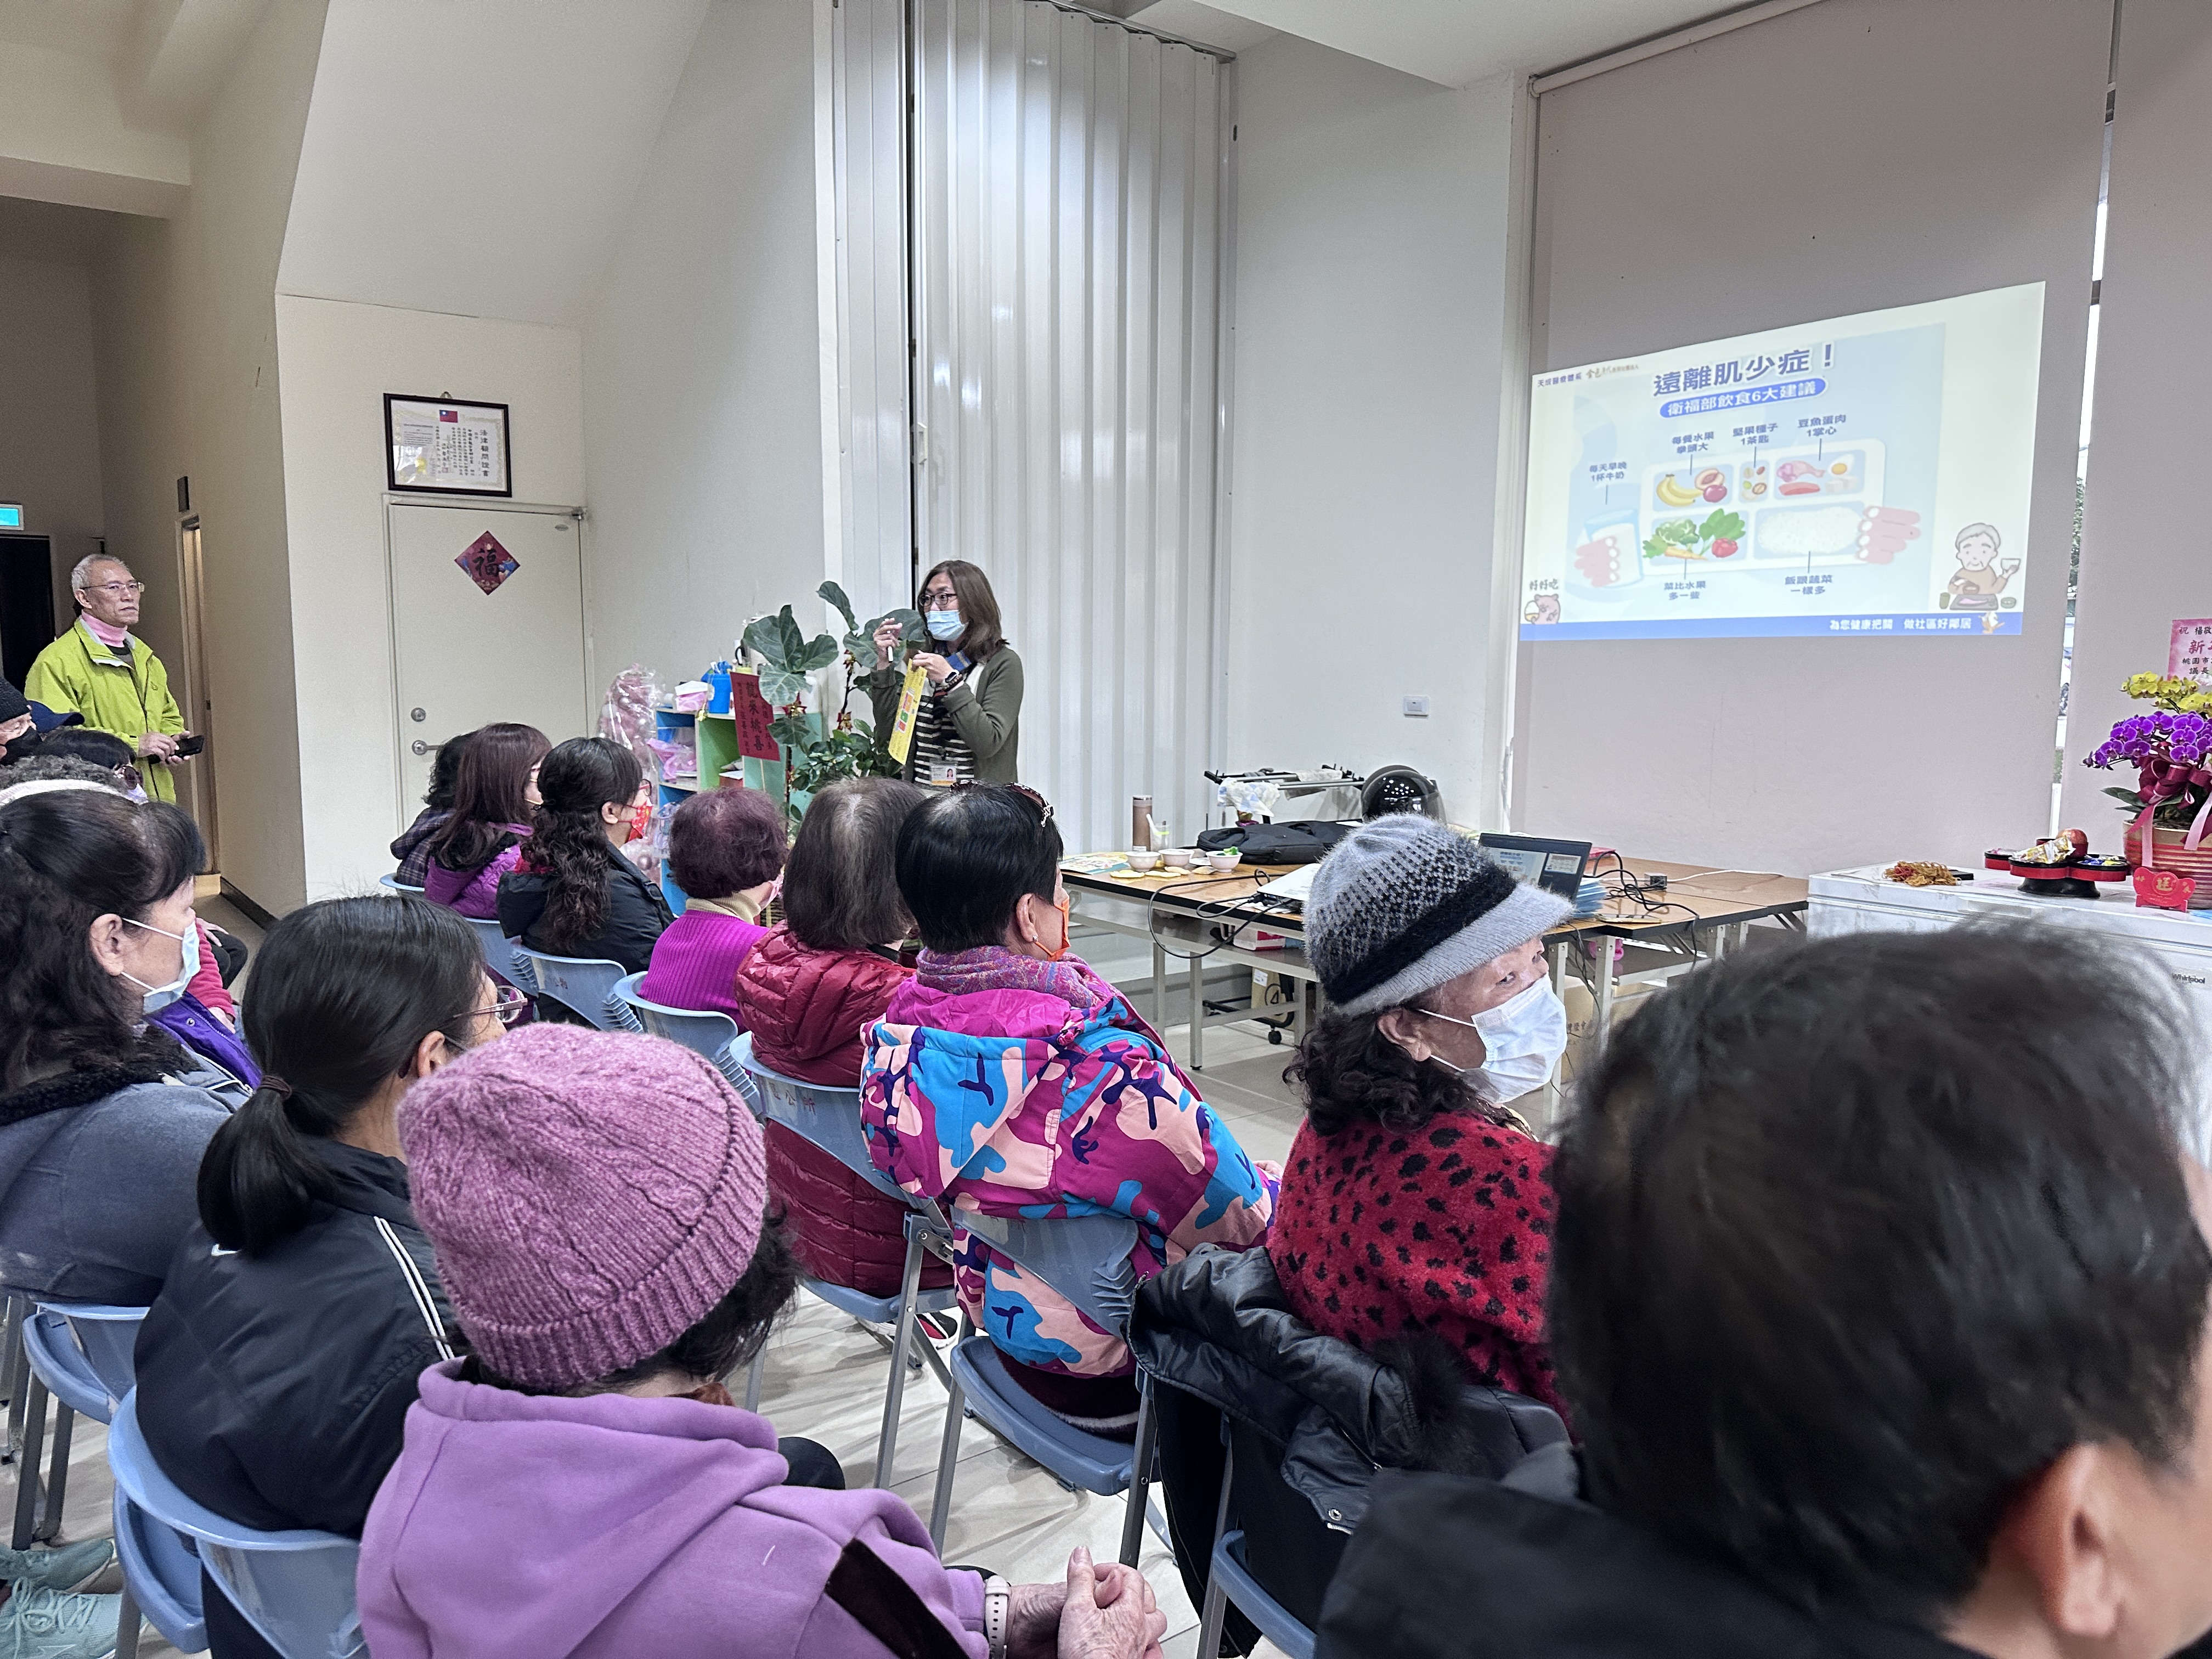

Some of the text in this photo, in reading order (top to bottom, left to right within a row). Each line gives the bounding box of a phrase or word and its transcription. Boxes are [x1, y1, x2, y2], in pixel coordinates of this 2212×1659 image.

[1654, 344, 1832, 396] 遠離肌少症！
[1667, 381, 1816, 416] 衛福部飲食6大建議
[1798, 414, 1847, 428] 豆魚蛋肉
[1733, 423, 1778, 437] 堅果種子
[1807, 426, 1837, 437] 1掌心
[1672, 431, 1714, 444] 每餐水果
[1741, 435, 1769, 445] 1茶匙
[1592, 471, 1624, 482] 1杯牛奶
[2182, 657, 2212, 665] 桃園市
